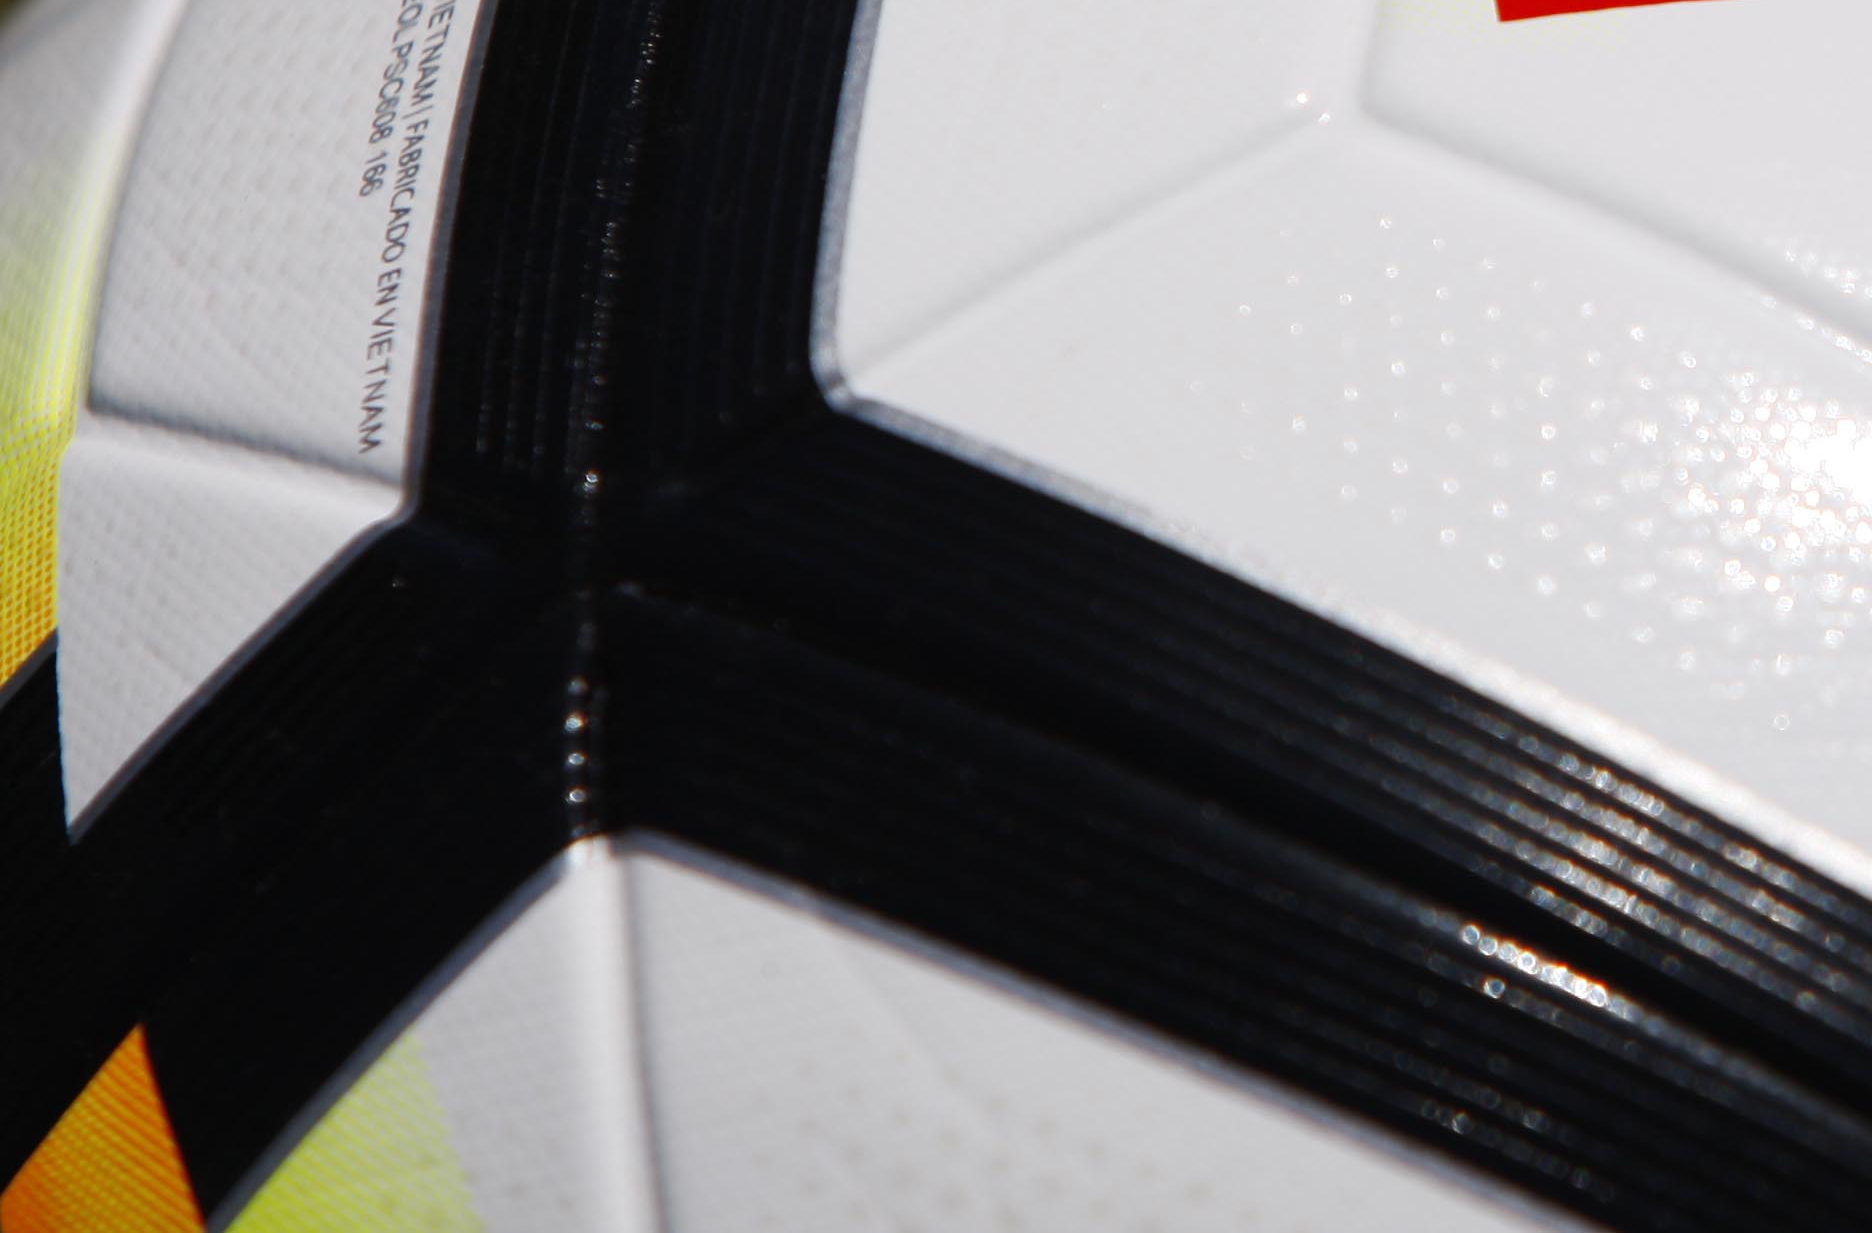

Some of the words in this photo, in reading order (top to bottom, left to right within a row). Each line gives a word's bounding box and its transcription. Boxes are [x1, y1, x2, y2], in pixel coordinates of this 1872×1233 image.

[358, 149, 388, 198] 166
[381, 119, 430, 264] FABRICADO
[374, 267, 403, 307] EN
[358, 306, 397, 455] VIETNAM
